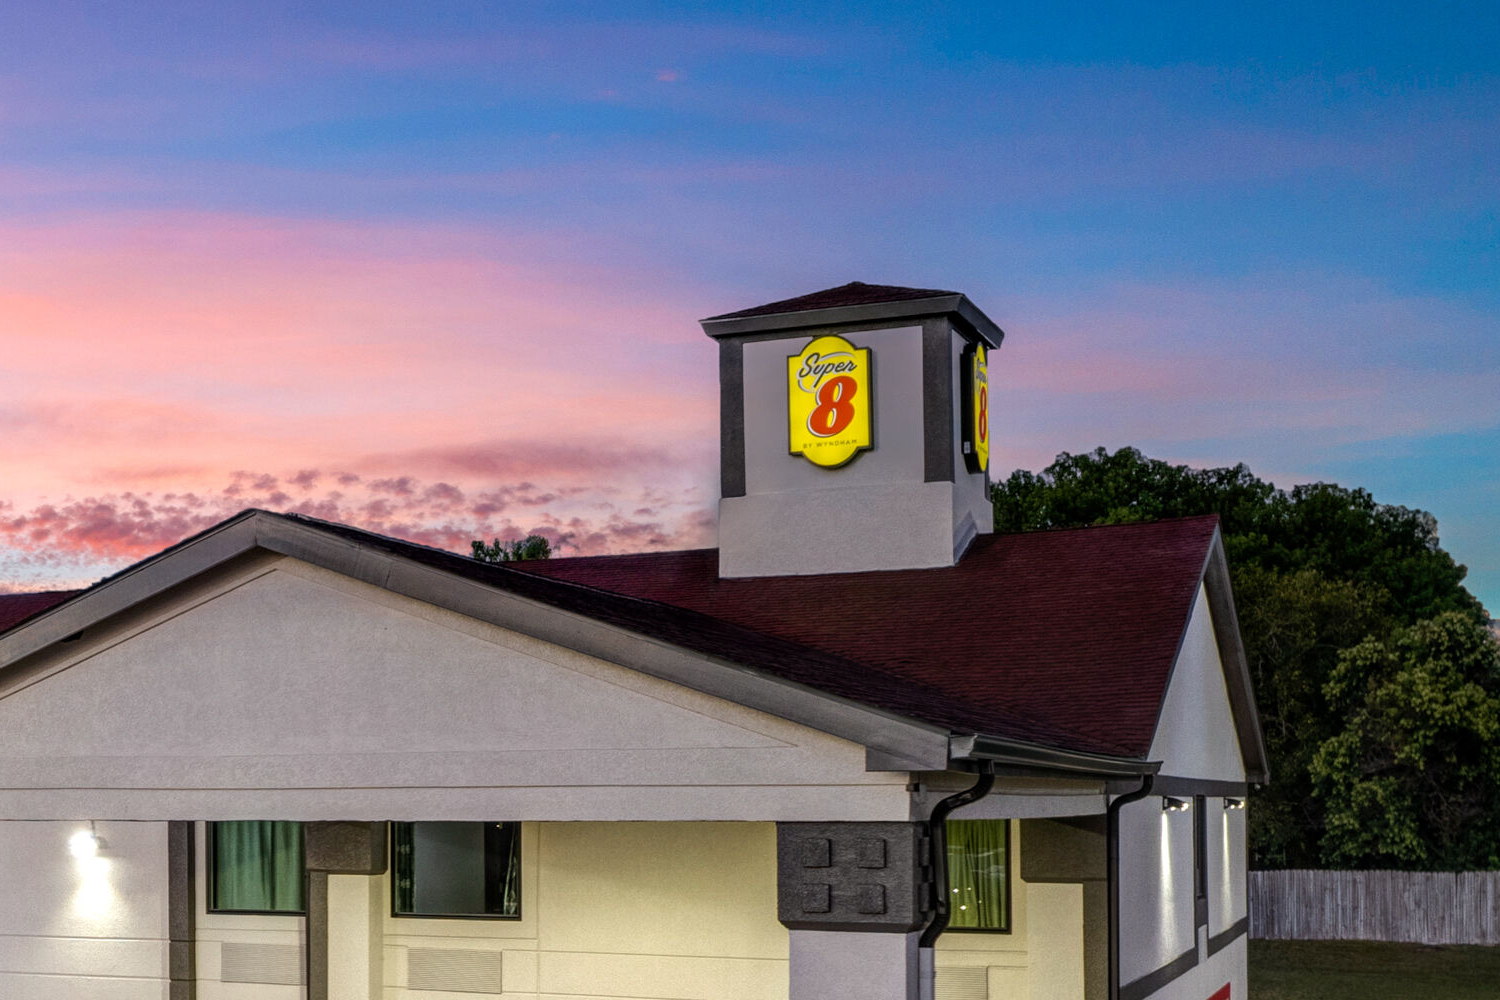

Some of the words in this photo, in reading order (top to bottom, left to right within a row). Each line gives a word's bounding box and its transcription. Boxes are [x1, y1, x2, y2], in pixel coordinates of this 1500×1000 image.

[797, 352, 858, 388] Super
[807, 375, 858, 438] 8
[979, 386, 987, 443] 8
[816, 439, 857, 448] WYNDHAM
